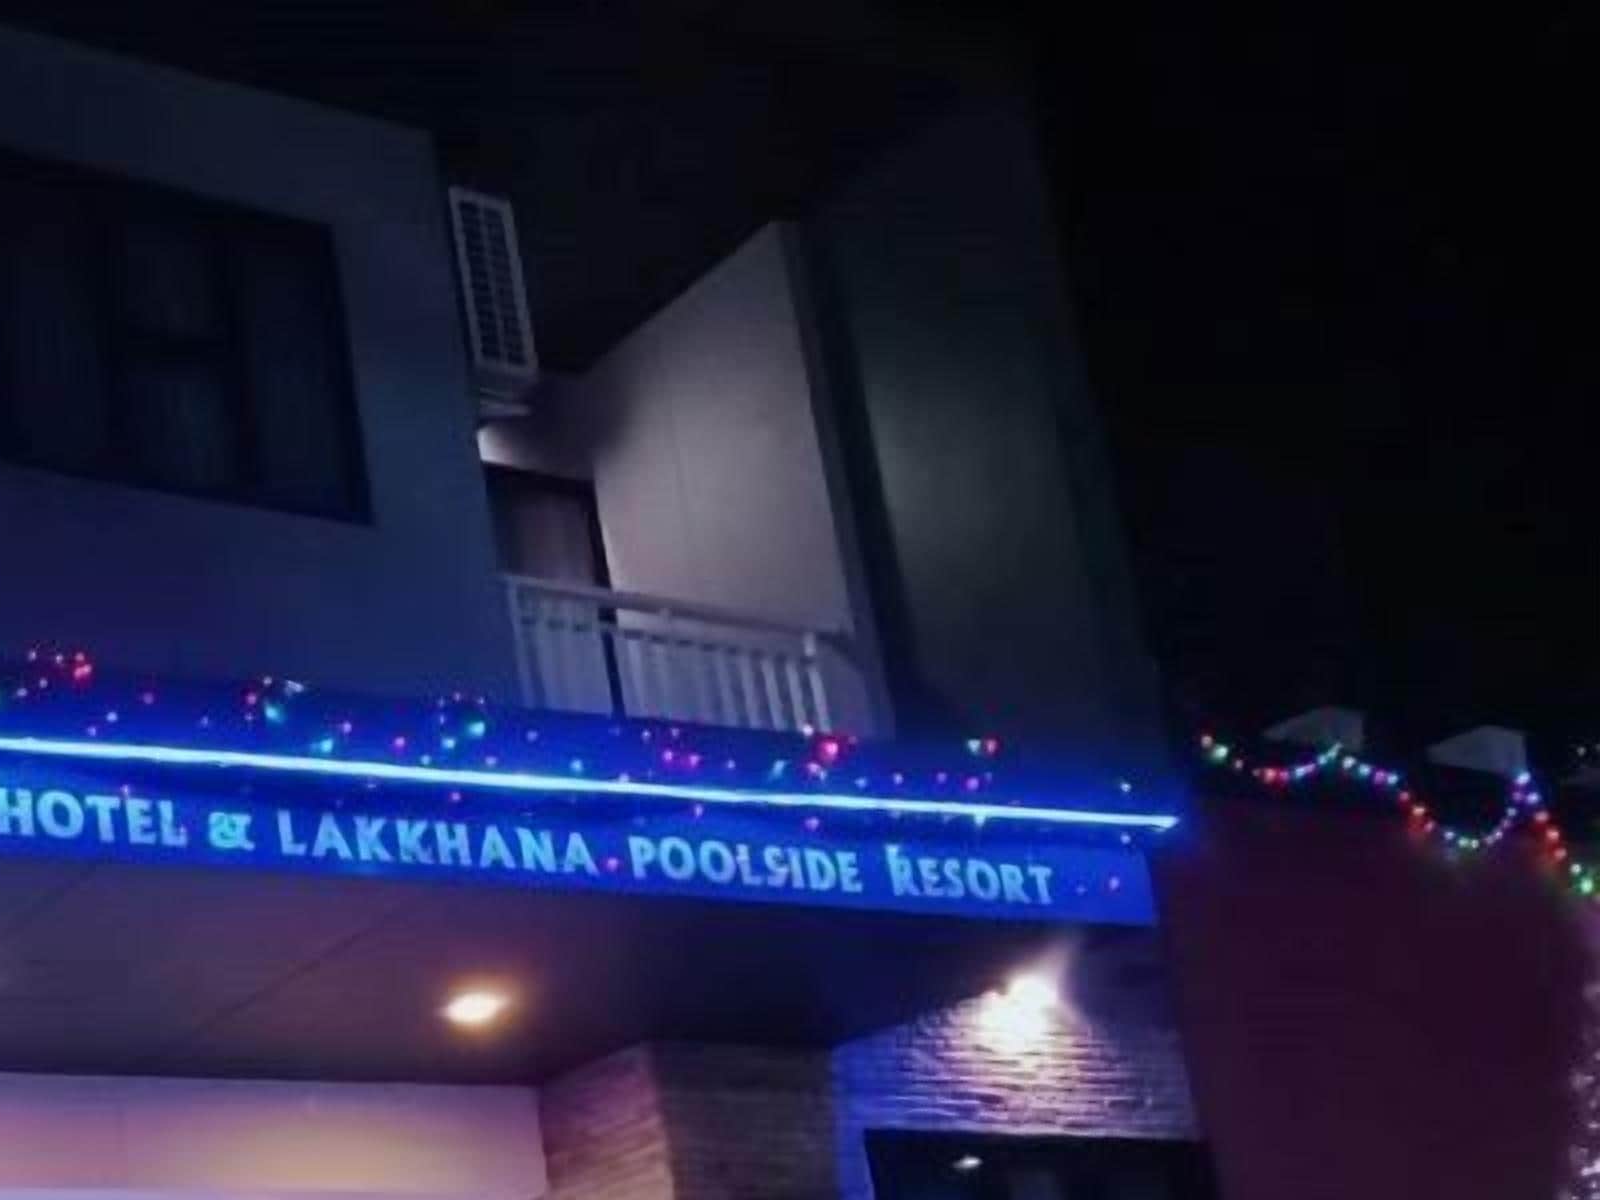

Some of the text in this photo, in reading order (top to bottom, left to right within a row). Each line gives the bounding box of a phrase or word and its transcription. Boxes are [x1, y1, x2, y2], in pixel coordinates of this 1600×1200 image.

[207, 811, 255, 850] &
[277, 811, 599, 876] LAKKHANA
[628, 835, 863, 892] POOLSIDE
[887, 845, 1055, 905] RESORT
